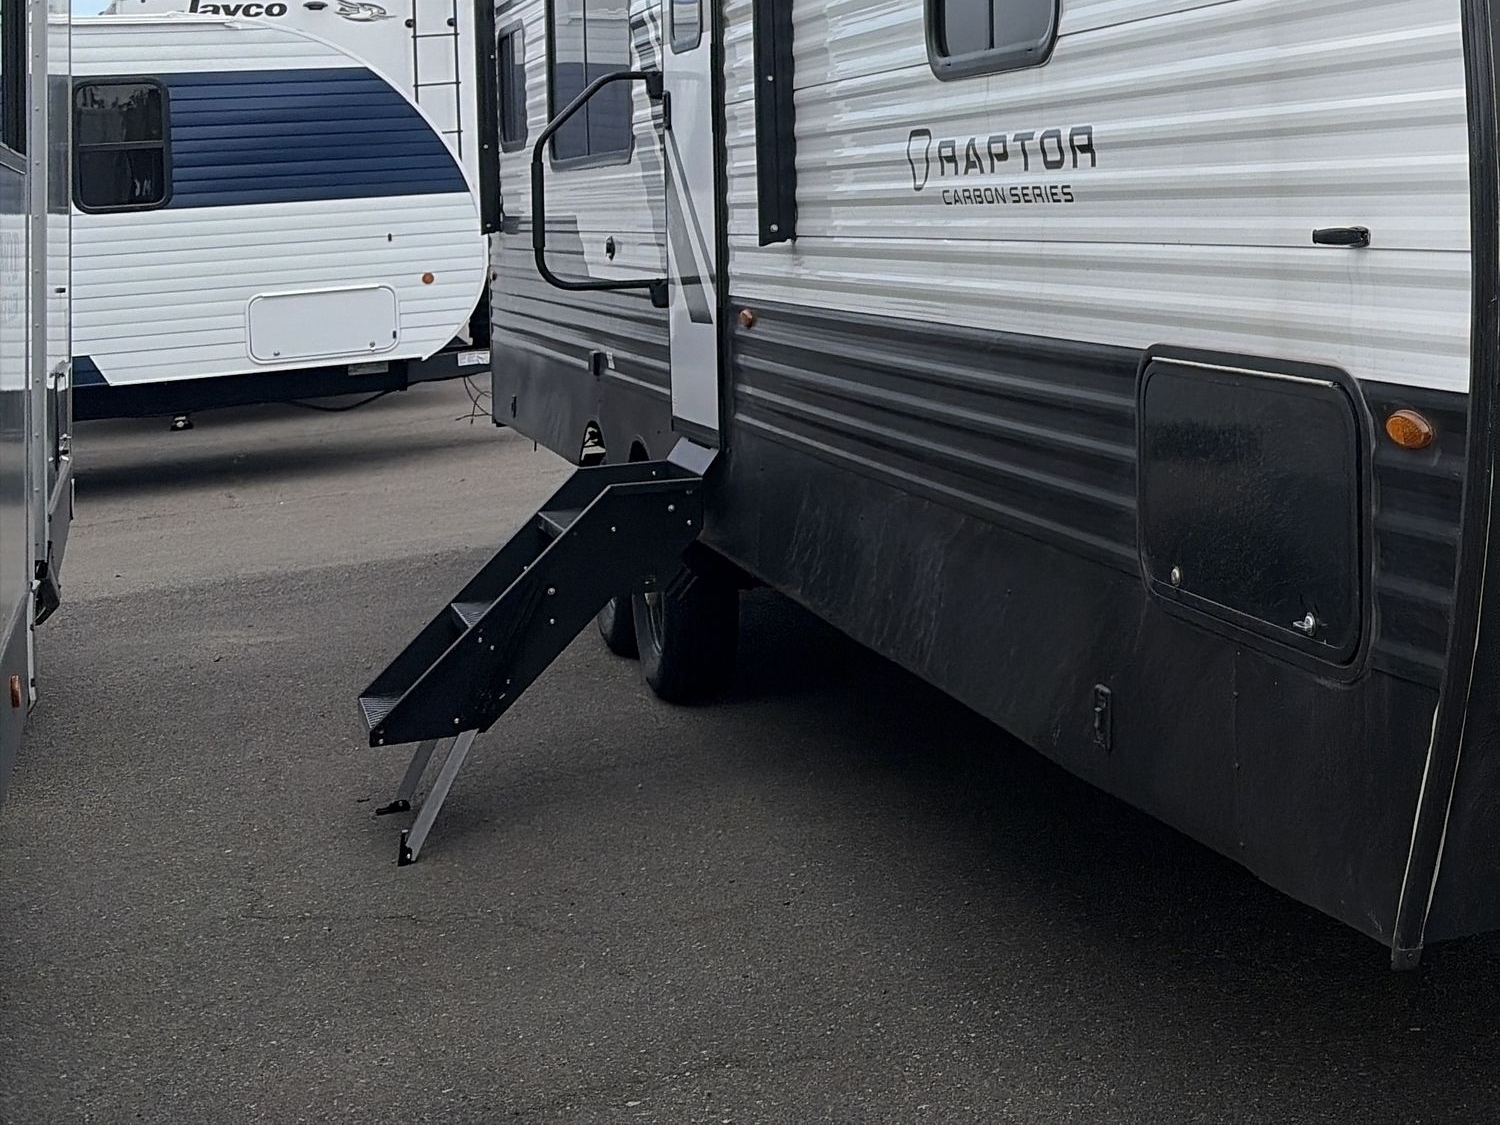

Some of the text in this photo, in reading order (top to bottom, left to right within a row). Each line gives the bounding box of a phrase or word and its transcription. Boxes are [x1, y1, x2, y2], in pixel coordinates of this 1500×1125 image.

[937, 125, 1097, 176] RAPTOR
[942, 184, 1075, 206] CARBON SERIES
